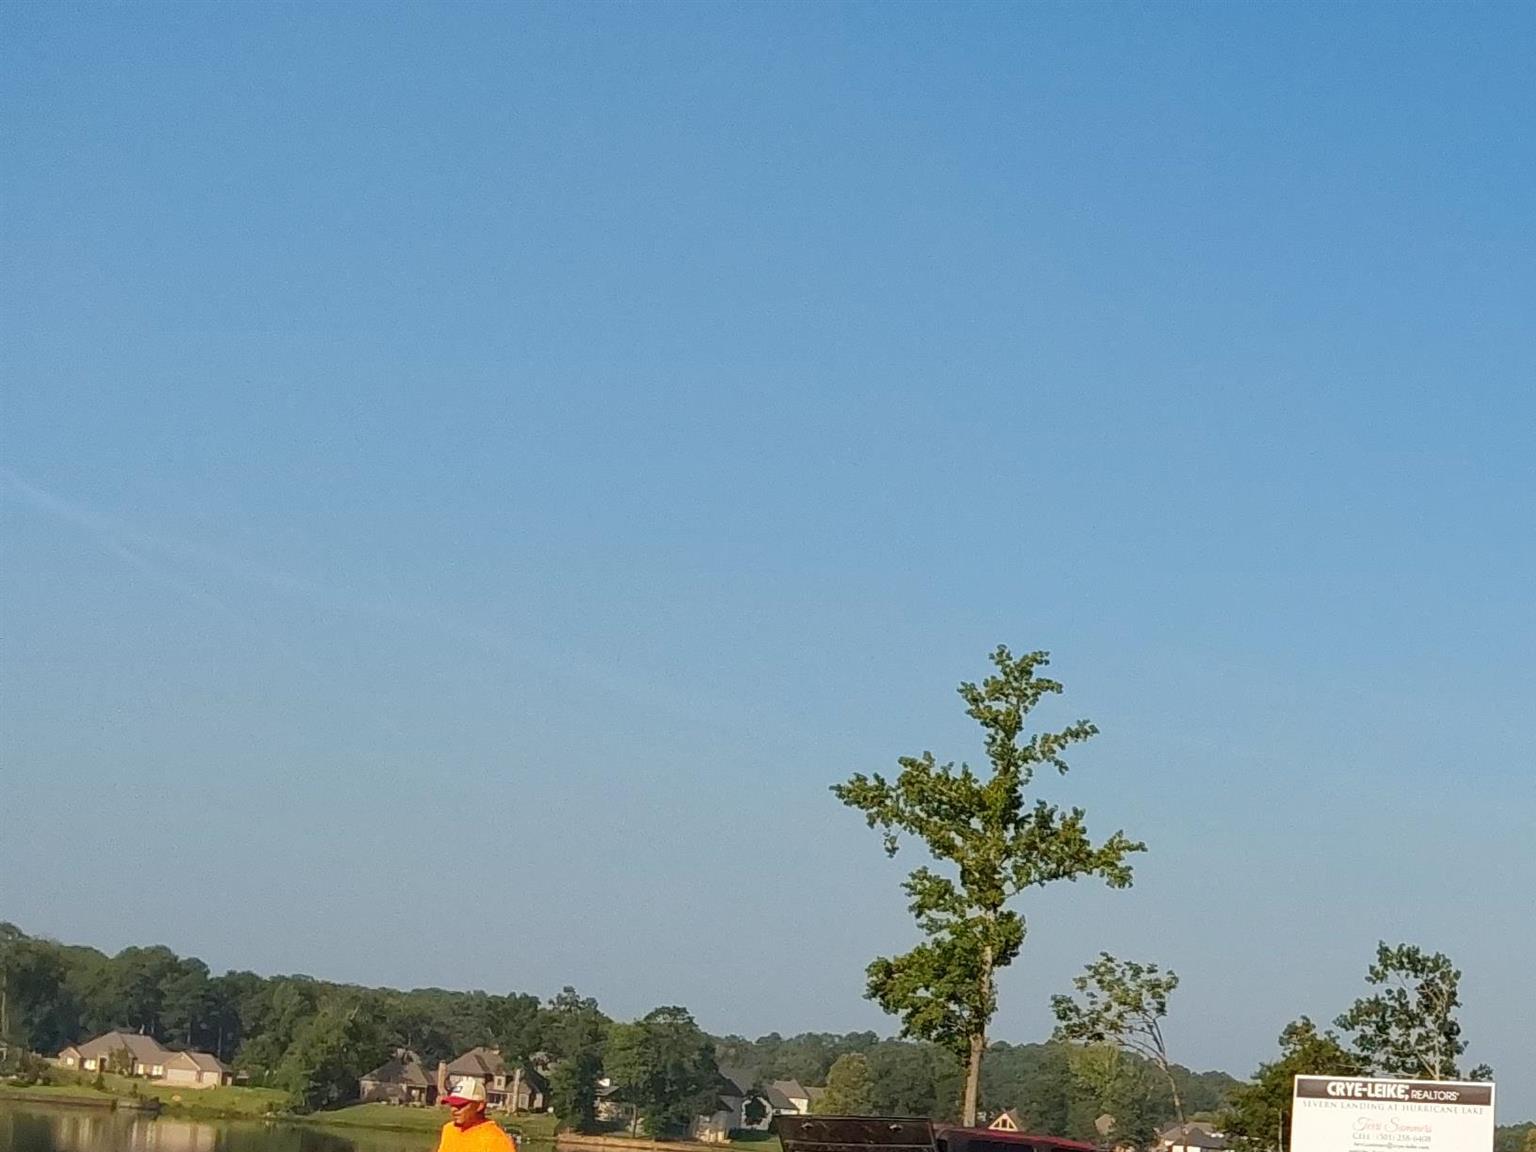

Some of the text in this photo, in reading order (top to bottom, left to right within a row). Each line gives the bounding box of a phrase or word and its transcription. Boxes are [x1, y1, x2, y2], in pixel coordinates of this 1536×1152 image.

[1341, 1102, 1385, 1111] LANDING
[1387, 1103, 1398, 1111] AT
[1402, 1104, 1458, 1114] HURRICANE
[1462, 1107, 1483, 1115] LAKE
